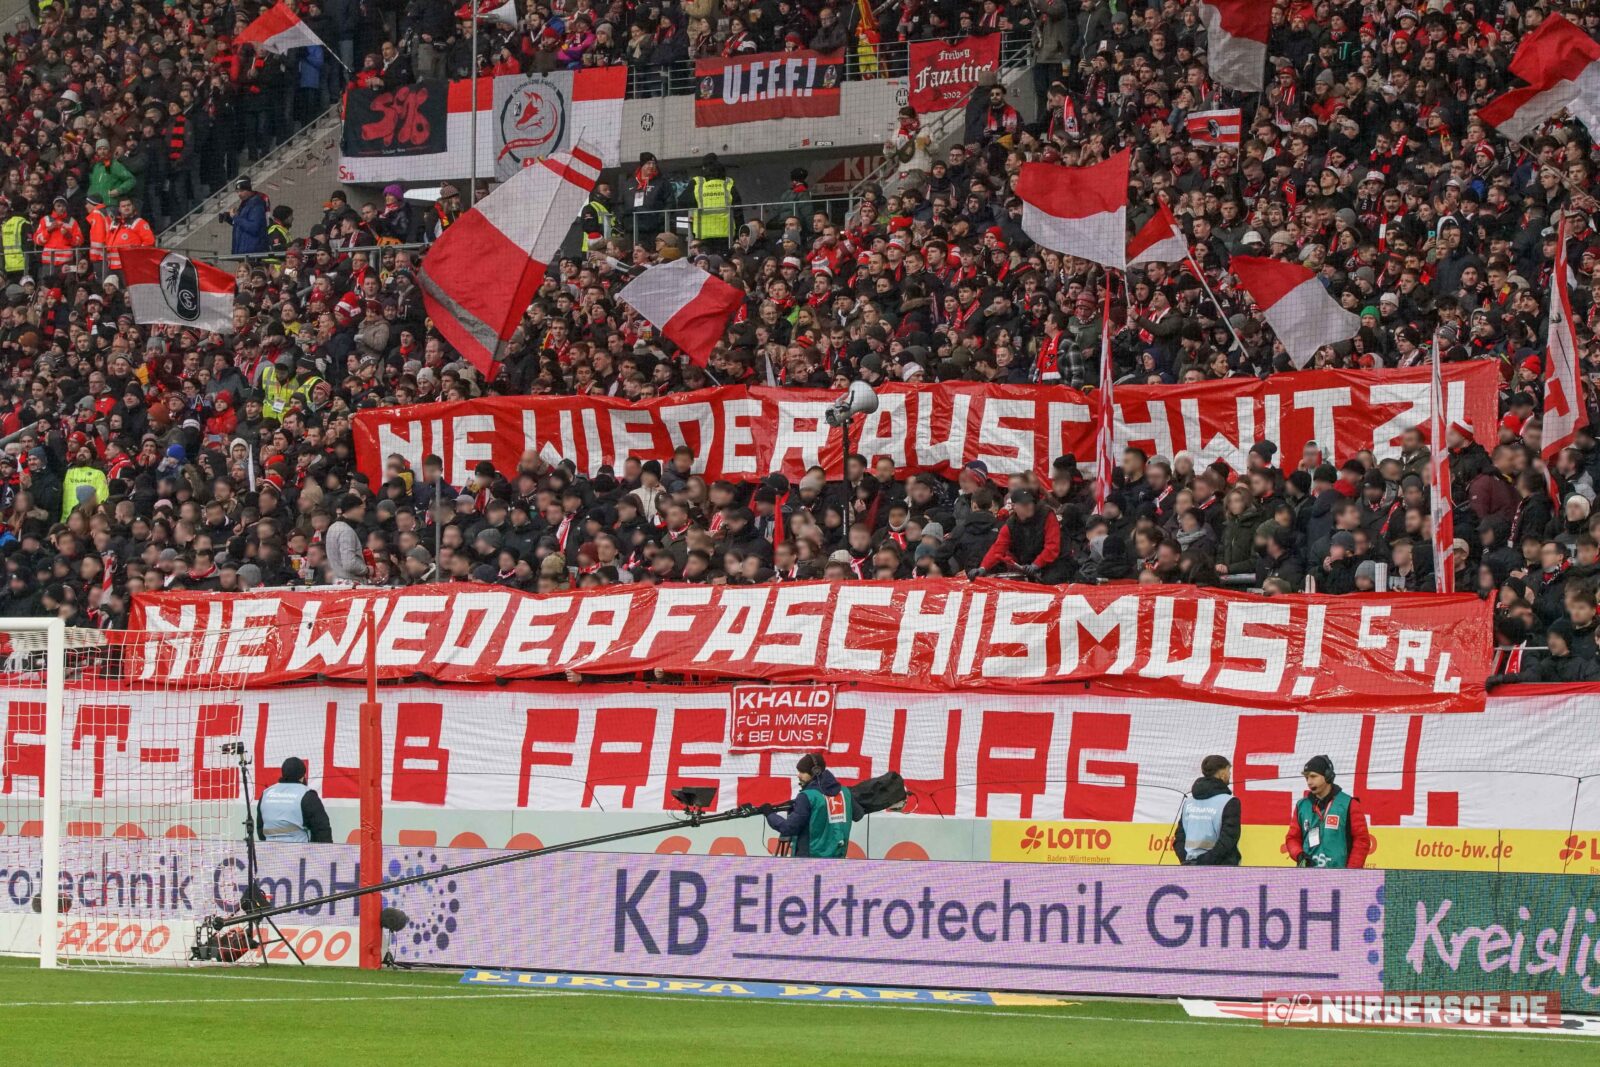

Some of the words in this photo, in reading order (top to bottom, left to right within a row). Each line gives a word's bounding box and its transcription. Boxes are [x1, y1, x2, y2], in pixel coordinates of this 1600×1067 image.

[943, 91, 961, 99] 2002
[378, 414, 496, 494] NIE
[523, 398, 832, 481] WIEDER
[857, 379, 1467, 479] AUSCHWITZ!
[138, 598, 283, 681] NIE
[285, 592, 634, 671] WIEDER
[631, 583, 1327, 696] FASCHISMUS!
[739, 690, 831, 710] KHALID
[737, 711, 770, 727] FÜR
[775, 713, 828, 726] IMMER
[748, 730, 774, 743] BEI
[778, 730, 814, 742] UNS
[1047, 828, 1112, 850] LOTTO
[1414, 839, 1513, 859] lotto-bw.de
[1047, 854, 1111, 864] Baden-Württemberg
[613, 868, 709, 956] KB
[732, 872, 1124, 945] Elektrotechnik
[1146, 883, 1341, 952] GmbH
[38, 920, 171, 955] AZOO
[1406, 900, 1600, 995] Kreisli
[469, 970, 756, 994] EUROPA
[778, 985, 982, 1002] PARK
